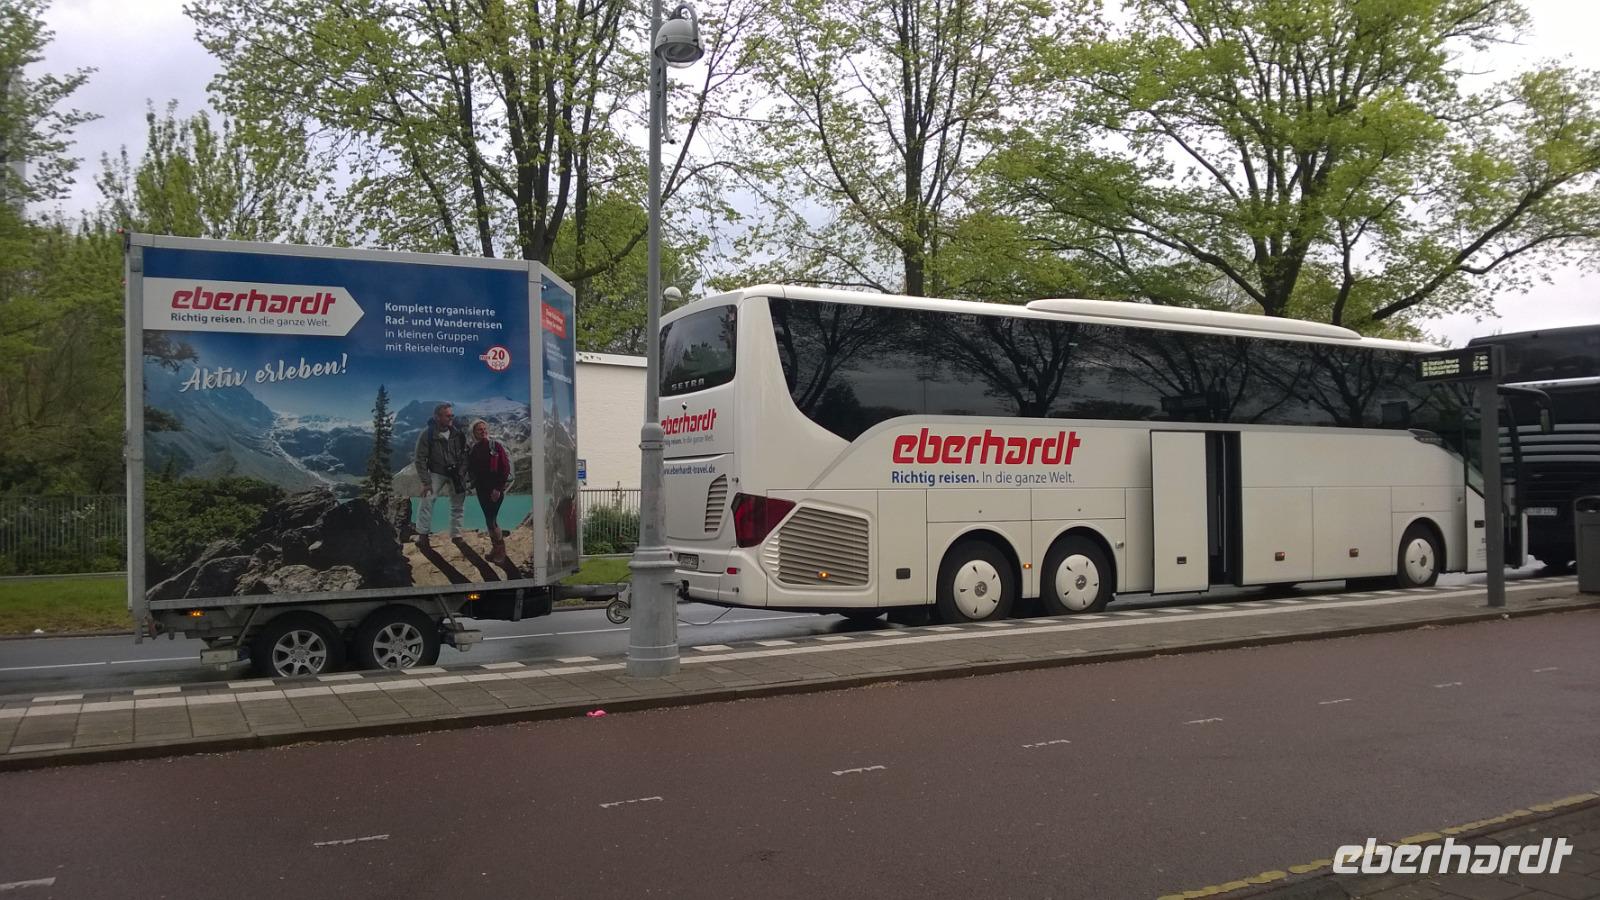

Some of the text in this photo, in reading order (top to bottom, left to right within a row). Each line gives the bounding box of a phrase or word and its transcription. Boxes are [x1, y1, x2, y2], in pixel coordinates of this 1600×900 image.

[171, 286, 335, 315] eberhardt
[385, 302, 496, 317] Komplett organisierte
[171, 313, 208, 324] Richtig
[211, 314, 246, 325] reisen.
[259, 315, 274, 325] die
[277, 317, 305, 327] ganze
[306, 316, 330, 327] Welt.
[385, 316, 503, 329] Rad- und Wanderreisen
[385, 329, 479, 342] in kleinen Gruppen
[385, 343, 465, 356] mit Reiseleitung
[491, 349, 505, 360] 20
[179, 353, 348, 393] Aktiv erleben!
[671, 378, 705, 391] SETRA
[893, 428, 1081, 465] eberhardt
[891, 471, 1075, 486] Richtig reisen. In die ganze Welt.
